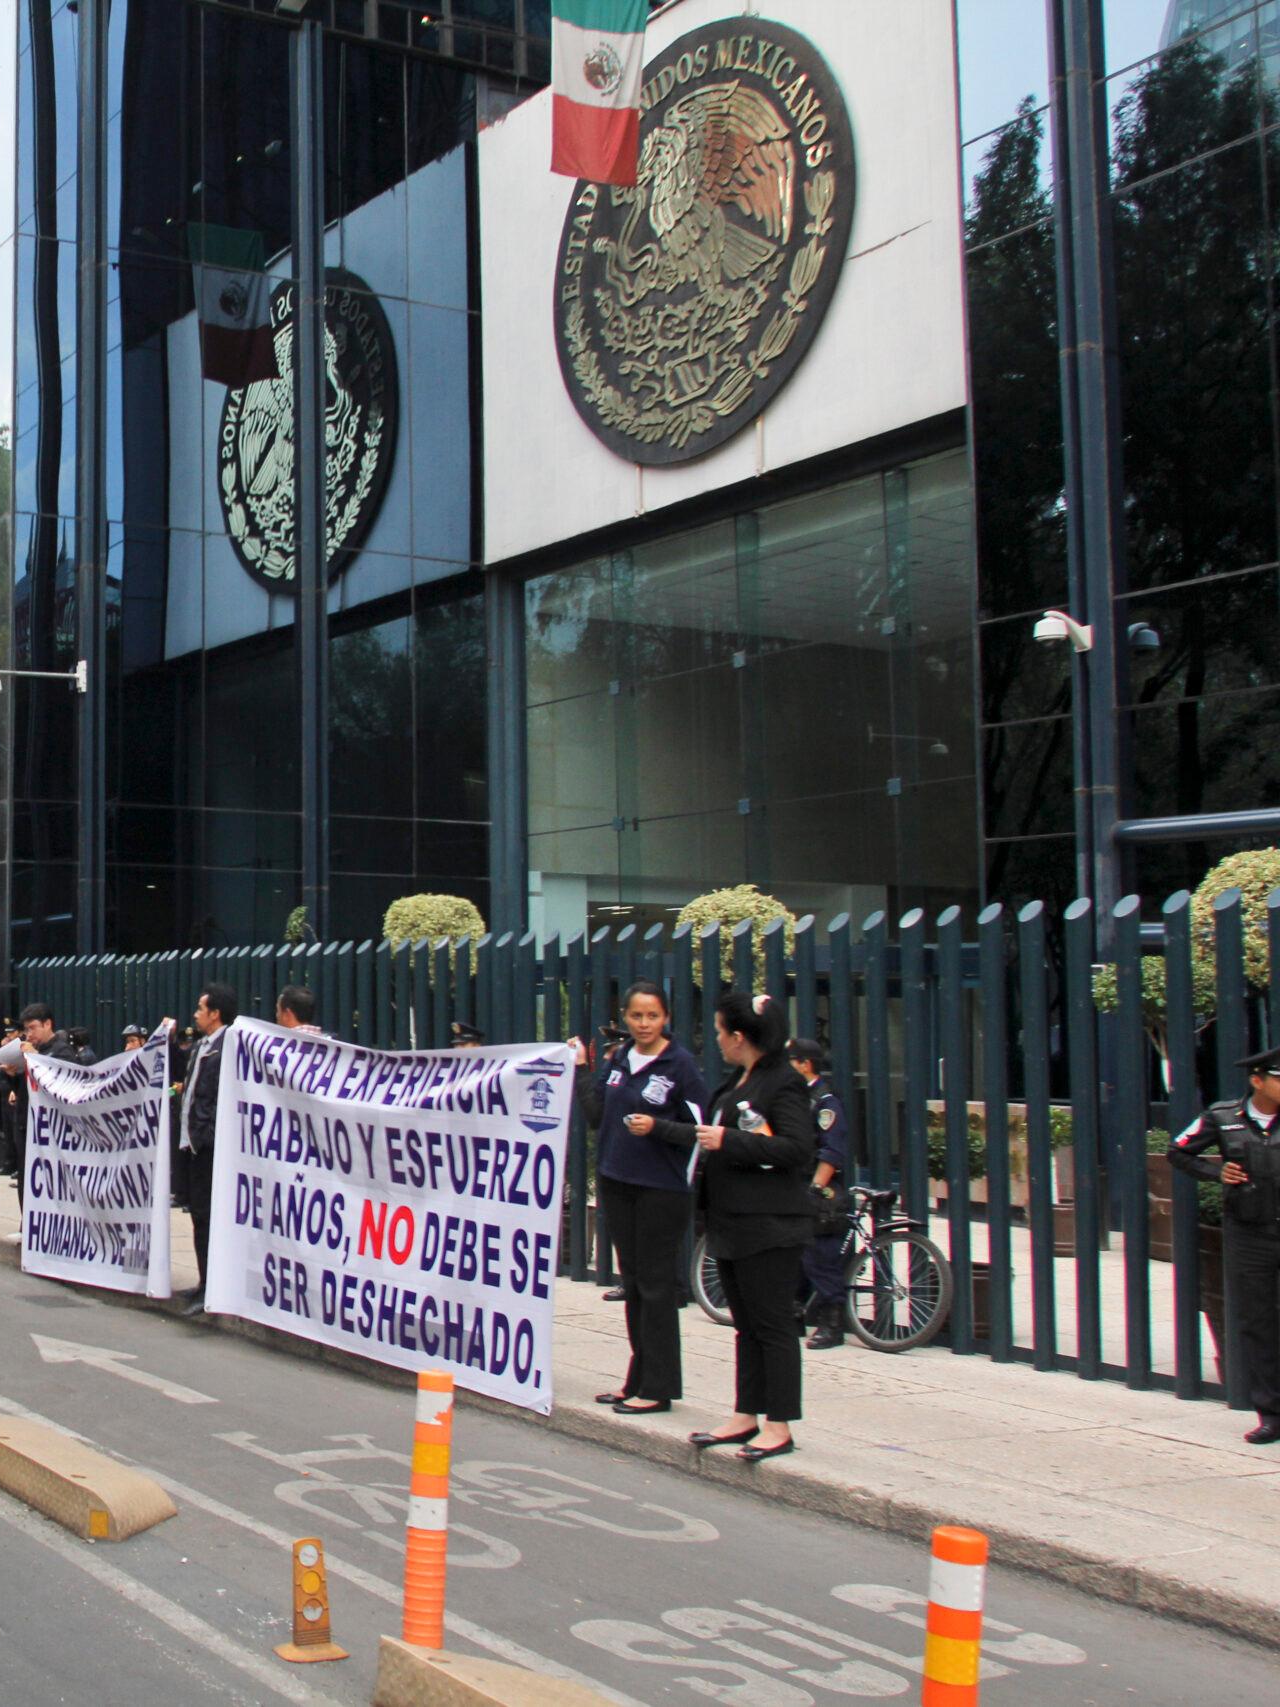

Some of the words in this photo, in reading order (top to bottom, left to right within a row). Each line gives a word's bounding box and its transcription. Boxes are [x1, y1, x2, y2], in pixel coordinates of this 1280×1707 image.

[561, 184, 601, 302] ESTAD
[639, 43, 708, 122] NIDOS
[713, 35, 833, 168] MEXICANOS
[236, 1030, 336, 1098] NUESTRA
[337, 1047, 509, 1116] EXPERIENCIA
[238, 1100, 352, 1175] TRABAJO
[357, 1122, 376, 1180] Y
[386, 1126, 555, 1210] ESFUERZO
[235, 1172, 262, 1229] DE
[270, 1173, 351, 1265] AÑOS,
[358, 1199, 415, 1266] NO
[420, 1211, 501, 1288] DEBE
[511, 1228, 552, 1300] SE
[262, 1251, 310, 1318] SER
[322, 1269, 542, 1390] DESHECHADO.
